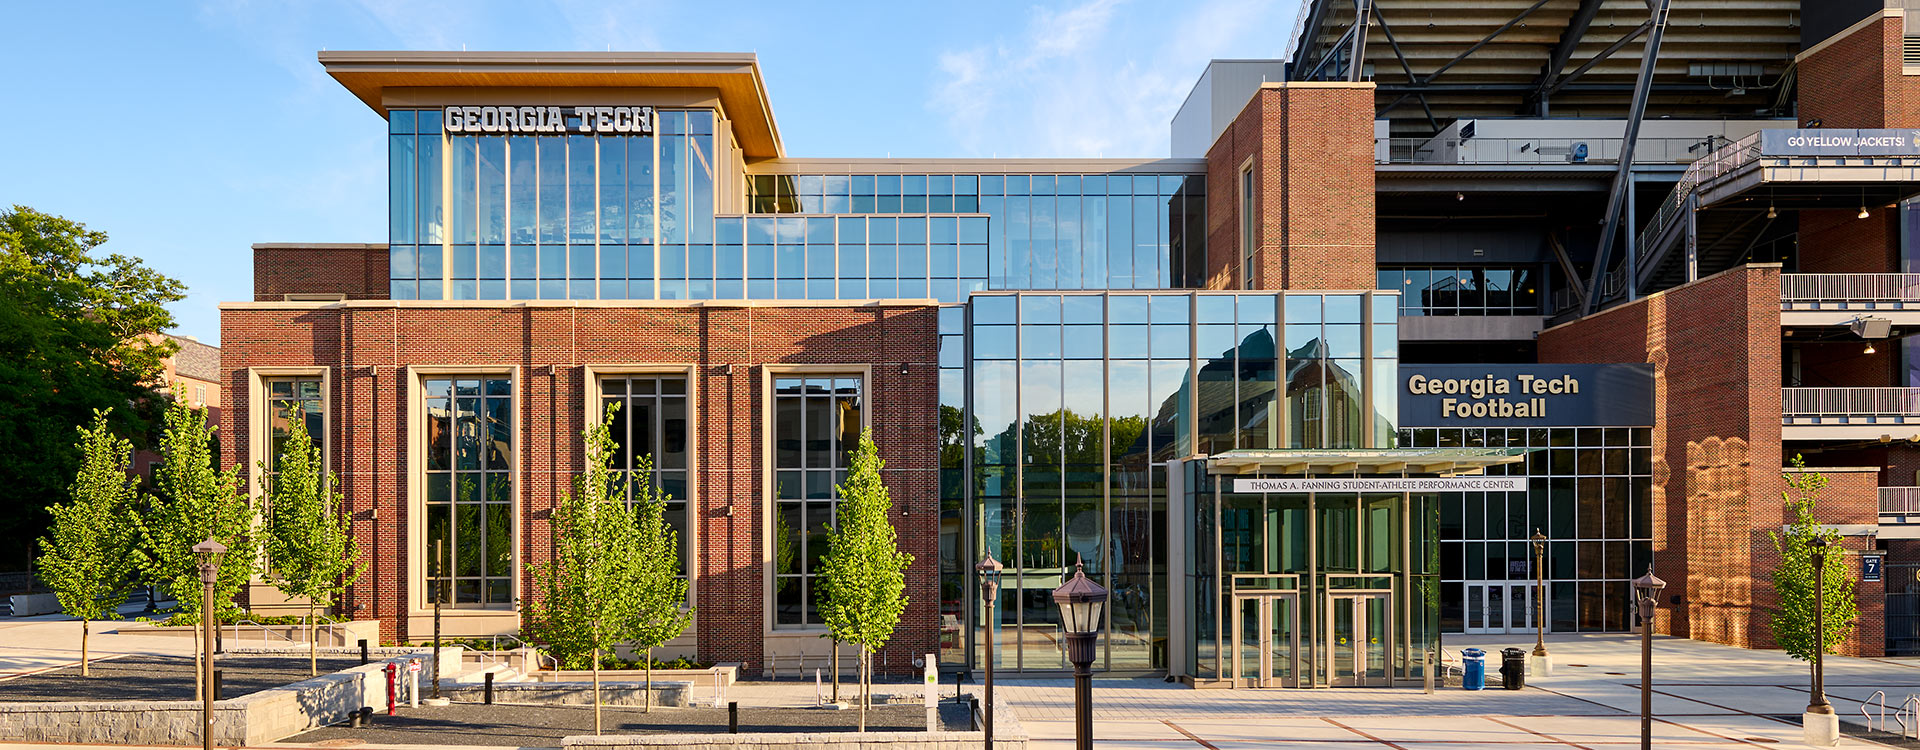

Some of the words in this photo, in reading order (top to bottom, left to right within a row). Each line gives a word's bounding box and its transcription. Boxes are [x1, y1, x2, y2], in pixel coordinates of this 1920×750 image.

[445, 106, 566, 132] GEORGIA
[574, 106, 652, 132] TECH
[1787, 136, 1805, 147] GO
[1806, 136, 1852, 147] YELLOW
[1853, 136, 1905, 147] JACKETS!
[1408, 374, 1510, 398] Georgia
[1517, 374, 1579, 394] Tech
[1442, 398, 1546, 418] Football
[1250, 481, 1289, 490] THOMAS
[1290, 481, 1299, 490] A.
[1301, 481, 1341, 490] FANNING
[1342, 481, 1416, 490] STUDENT-ATHLETE
[1418, 480, 1481, 489] PERFORMANCE
[1483, 480, 1514, 489] CENTER
[1868, 564, 1875, 573] 7
